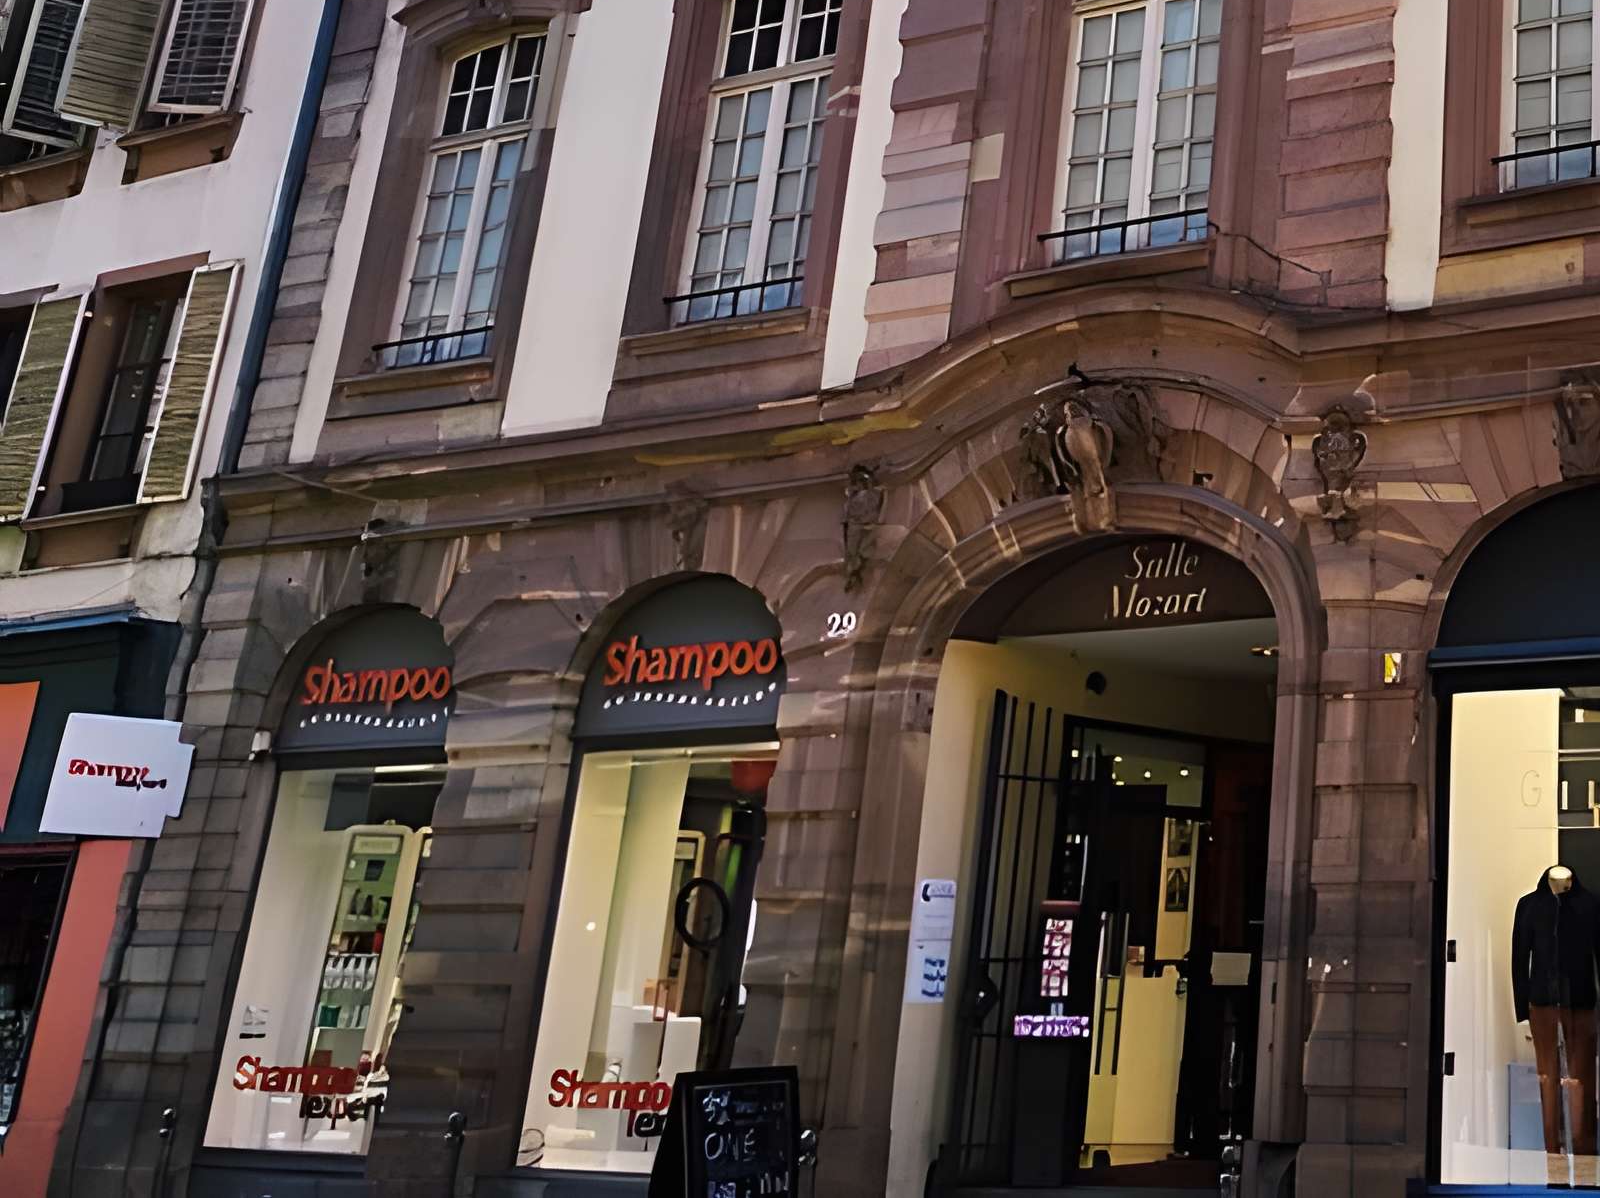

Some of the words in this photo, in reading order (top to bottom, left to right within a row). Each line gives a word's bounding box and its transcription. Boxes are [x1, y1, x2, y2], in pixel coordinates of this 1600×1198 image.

[1124, 542, 1199, 579] Salle
[827, 611, 857, 638] 29
[302, 658, 451, 714] Shampoo
[603, 634, 777, 691] Shampoo
[548, 1068, 673, 1138] Shampo
